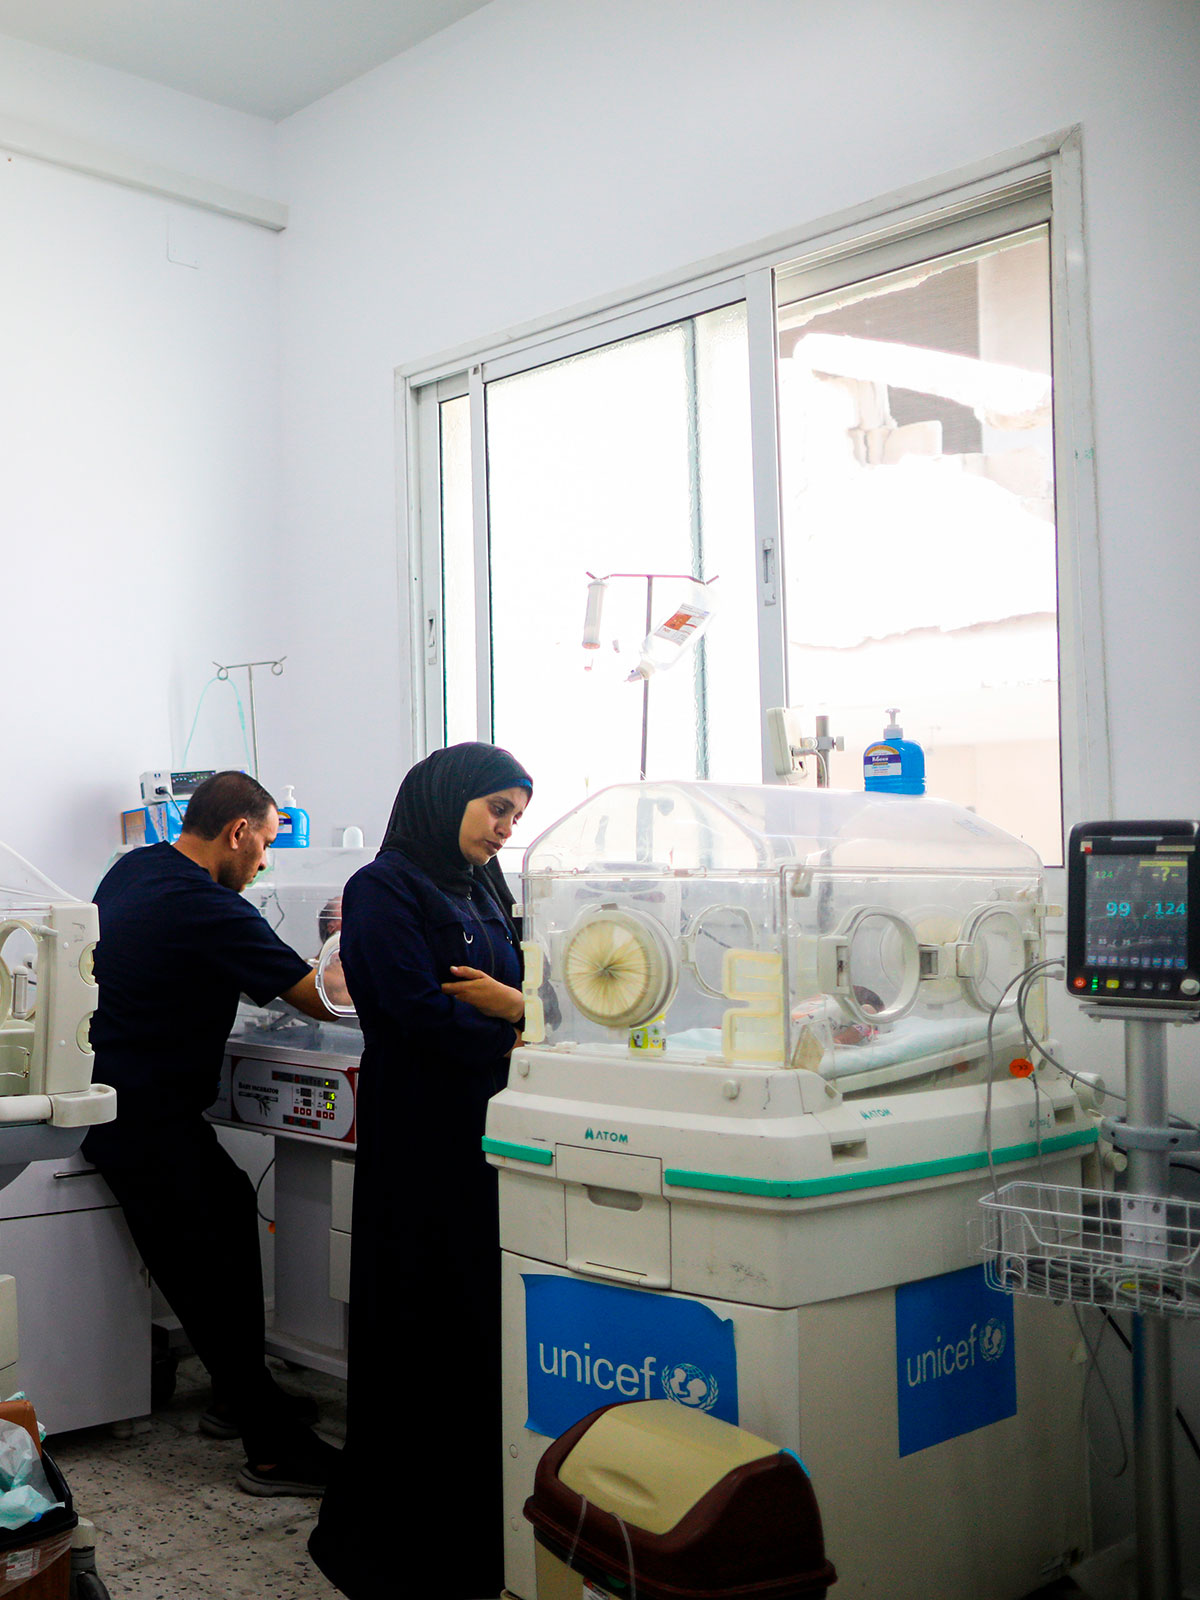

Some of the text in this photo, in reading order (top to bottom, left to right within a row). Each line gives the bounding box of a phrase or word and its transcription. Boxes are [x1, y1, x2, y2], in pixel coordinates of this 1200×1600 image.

[1106, 901, 1131, 917] 99
[1155, 902, 1186, 915] 124
[868, 1108, 892, 1118] ATOM
[595, 1130, 629, 1143] ATOM
[907, 1323, 977, 1387] unicef
[539, 1343, 657, 1400] unicef
